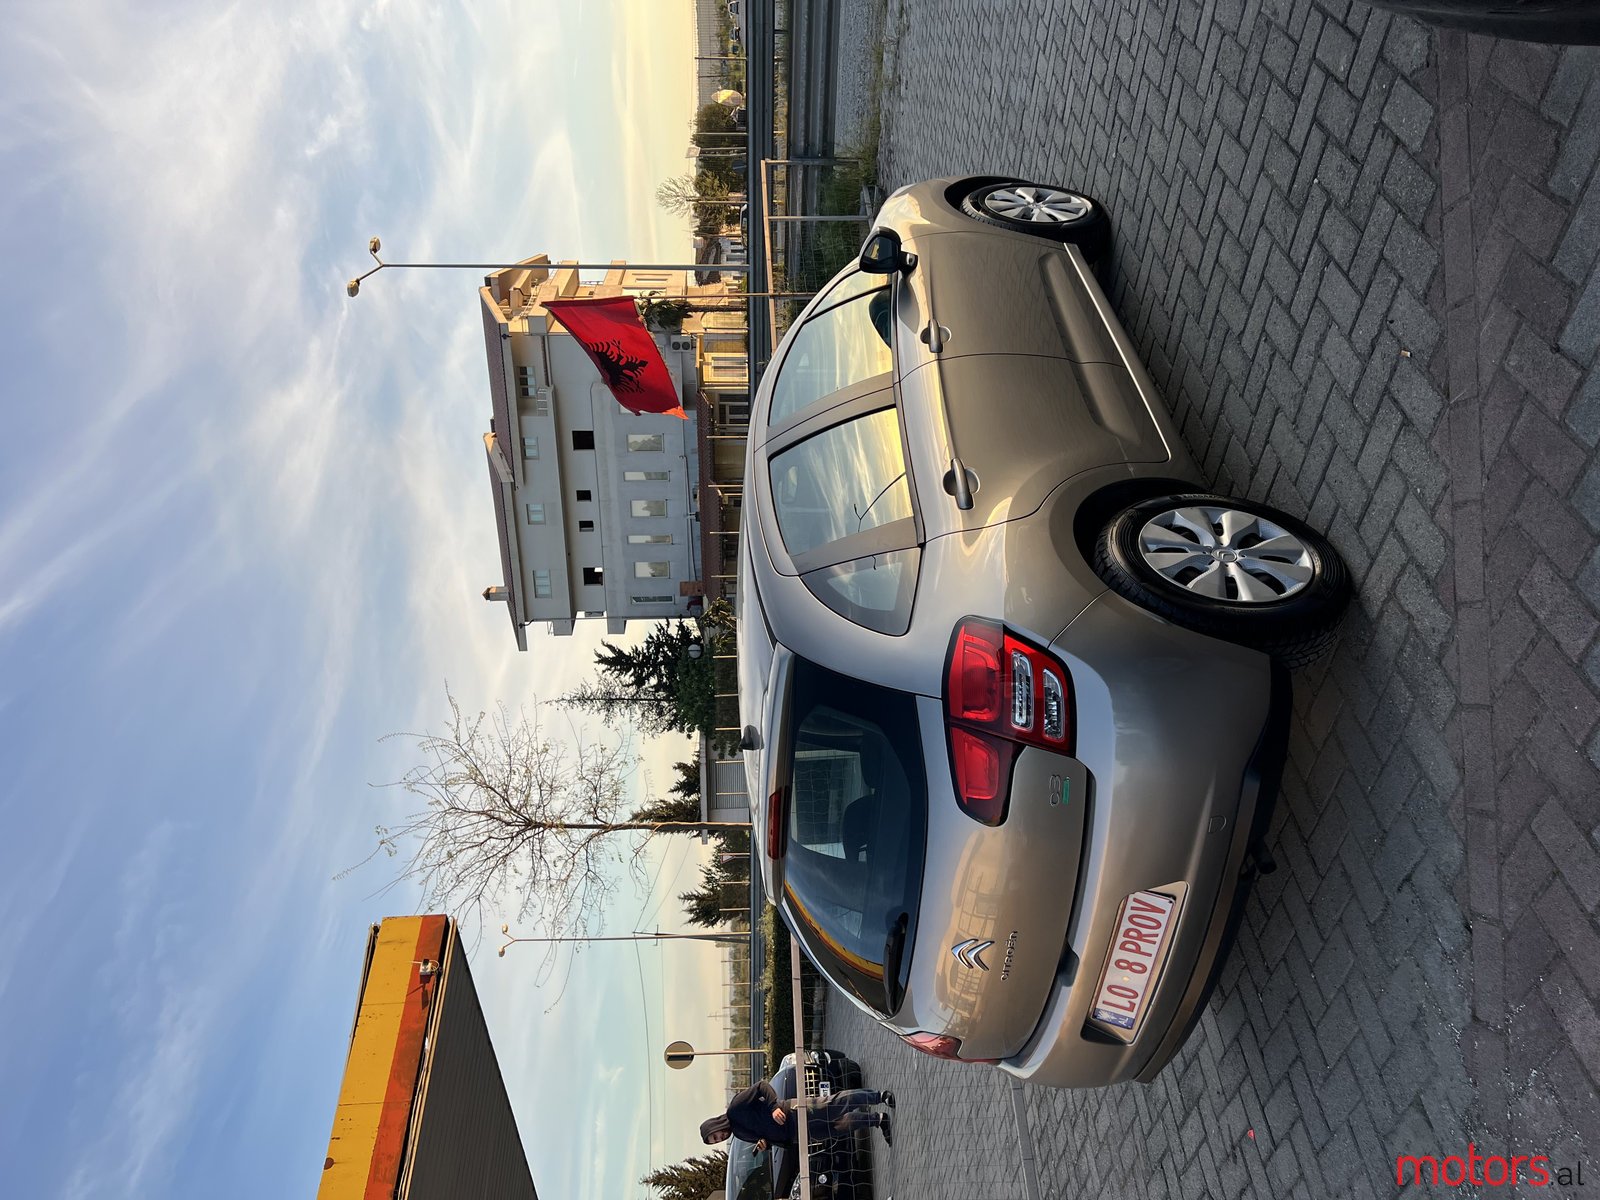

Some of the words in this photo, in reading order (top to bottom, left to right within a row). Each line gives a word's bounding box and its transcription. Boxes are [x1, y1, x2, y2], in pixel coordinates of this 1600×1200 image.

[1119, 897, 1167, 958] PROV
[1114, 958, 1148, 975] 8
[1102, 984, 1139, 1013] LO
